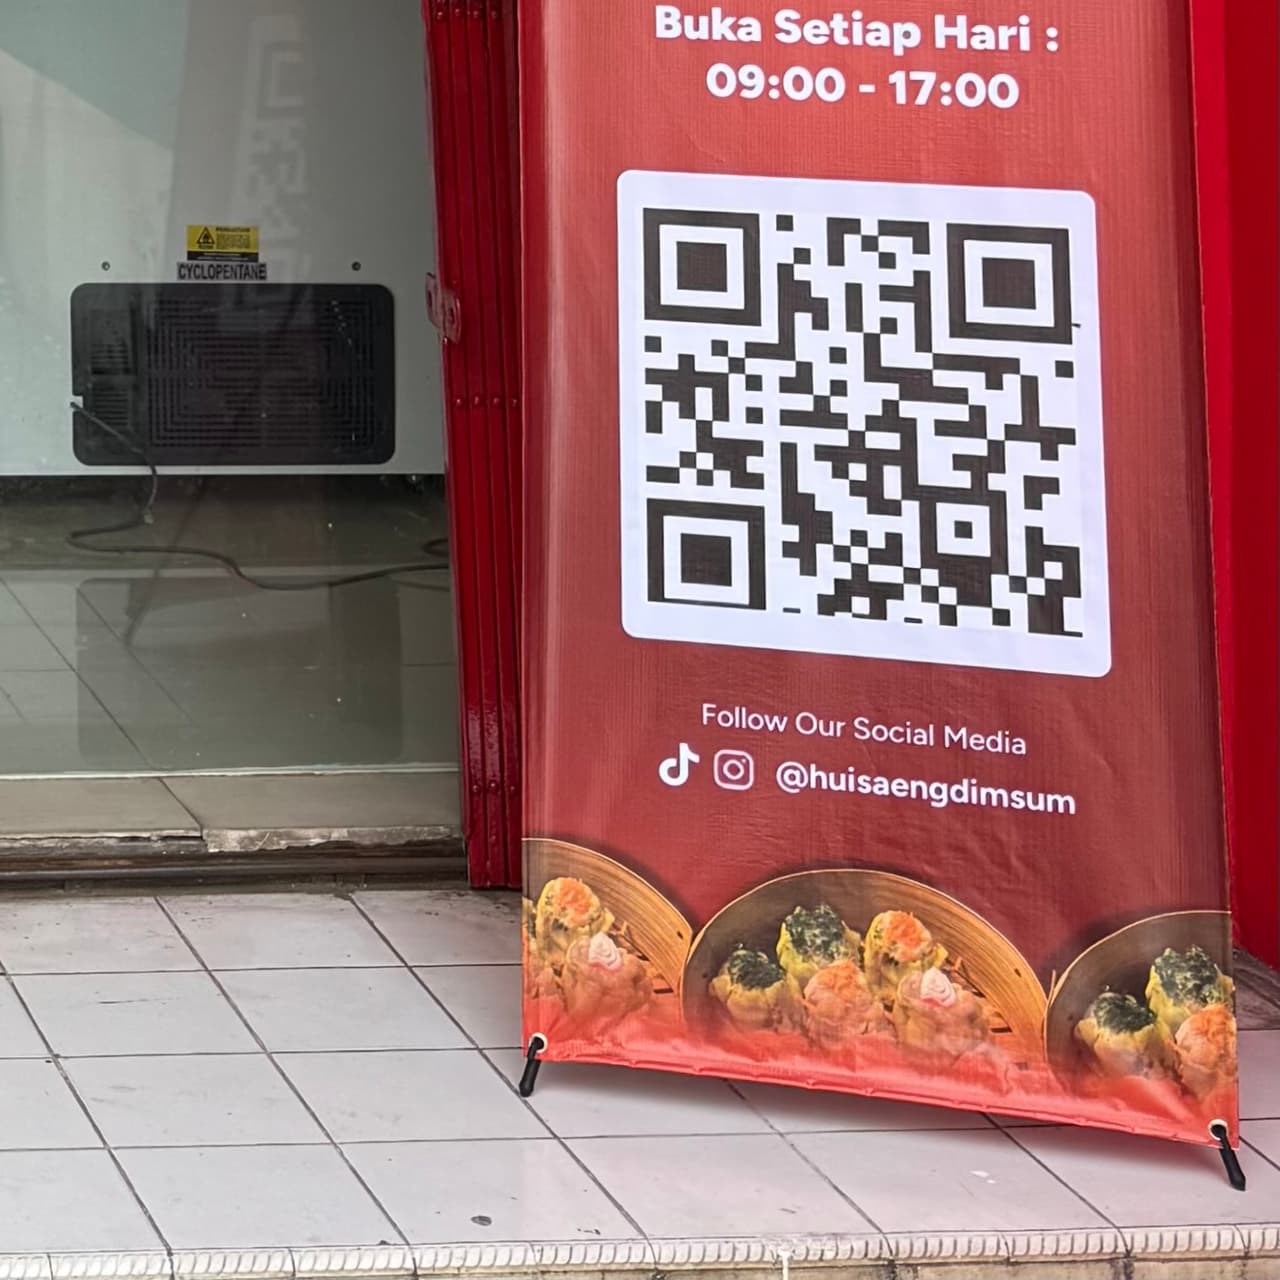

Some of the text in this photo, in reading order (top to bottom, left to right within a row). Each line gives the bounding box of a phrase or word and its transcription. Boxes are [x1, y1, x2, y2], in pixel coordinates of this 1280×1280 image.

[654, 4, 762, 42] Buka
[774, 9, 921, 56] Setiap
[934, 14, 1031, 52] Hari
[705, 62, 845, 103] 09:00
[887, 71, 1020, 109] 17:00
[178, 263, 267, 280] CYCLOPENTANE
[702, 703, 1027, 756] Follow Our Social Media
[776, 760, 1077, 815] @huisaengdimsum
